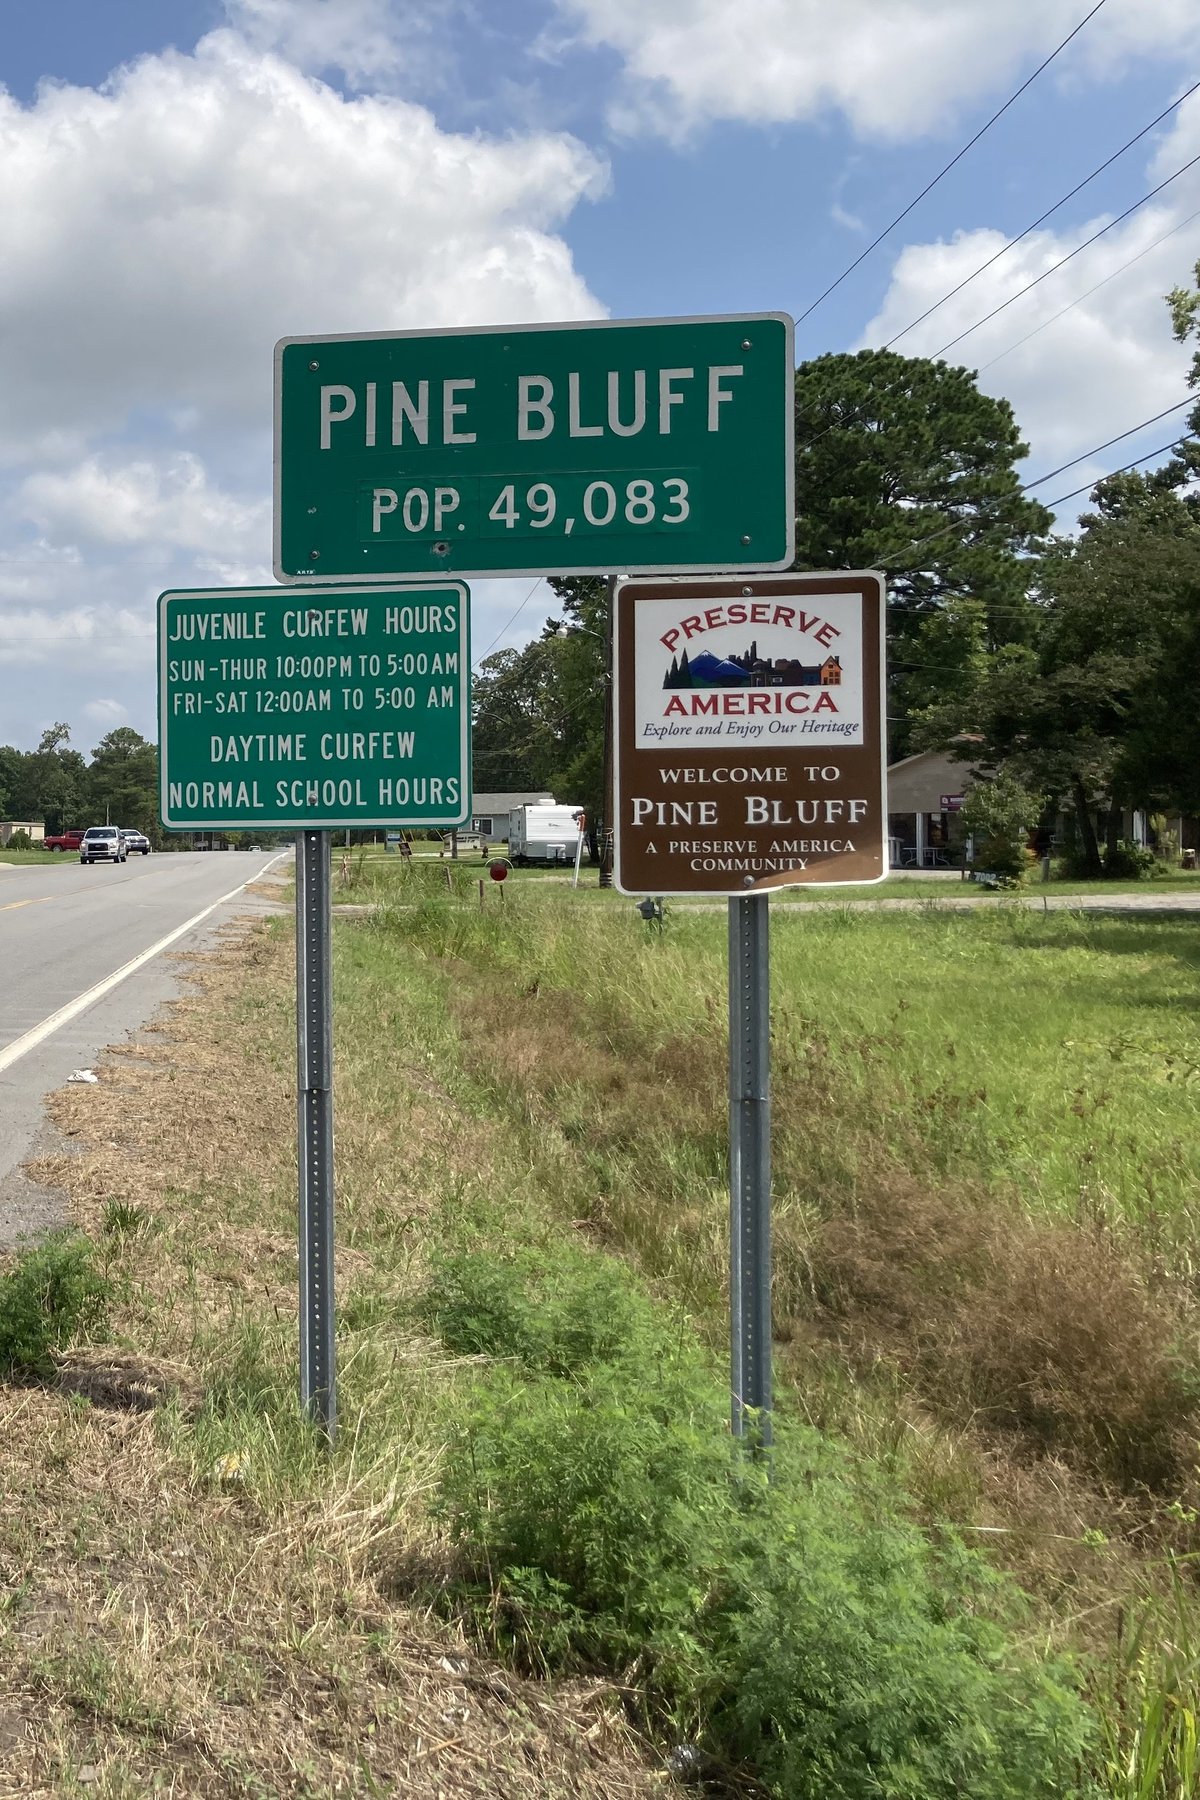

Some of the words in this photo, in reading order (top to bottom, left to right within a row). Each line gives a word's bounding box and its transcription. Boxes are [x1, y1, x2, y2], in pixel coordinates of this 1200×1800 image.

[320, 378, 477, 450] PINE
[517, 365, 744, 441] BLUFF
[371, 487, 466, 533] POP.
[488, 478, 691, 534] 49,083
[169, 611, 267, 642] JUVENILE
[283, 608, 369, 638] CURFEW
[385, 605, 457, 635] HOURS
[658, 602, 842, 654] PRESERVE
[276, 655, 352, 680] 10:00PM
[359, 654, 380, 677] TO
[173, 691, 248, 716] FRI-SAT
[256, 689, 331, 714] 12:00AM
[343, 688, 364, 710] TO
[375, 686, 415, 710] 5:00
[427, 685, 454, 708] AM
[662, 690, 839, 718] AMERICA
[642, 721, 692, 740] Explore
[695, 720, 724, 736] and
[725, 721, 764, 738] Enjoy
[768, 719, 797, 735] Our
[800, 718, 860, 737] Heritage
[210, 734, 307, 763] DAYTIME
[320, 731, 416, 760] CURFEW
[658, 766, 788, 784] WELCOME
[803, 765, 841, 782] TO
[169, 780, 264, 809] NORMAL
[276, 779, 368, 808] SCHOOL
[379, 777, 459, 806] HOURS
[630, 797, 718, 827] PINE
[744, 795, 868, 825] BLUFF
[645, 841, 658, 854] A
[669, 840, 757, 854] PRESERVE
[769, 838, 857, 853] AMERICA
[690, 857, 809, 872] COMMUNITY
